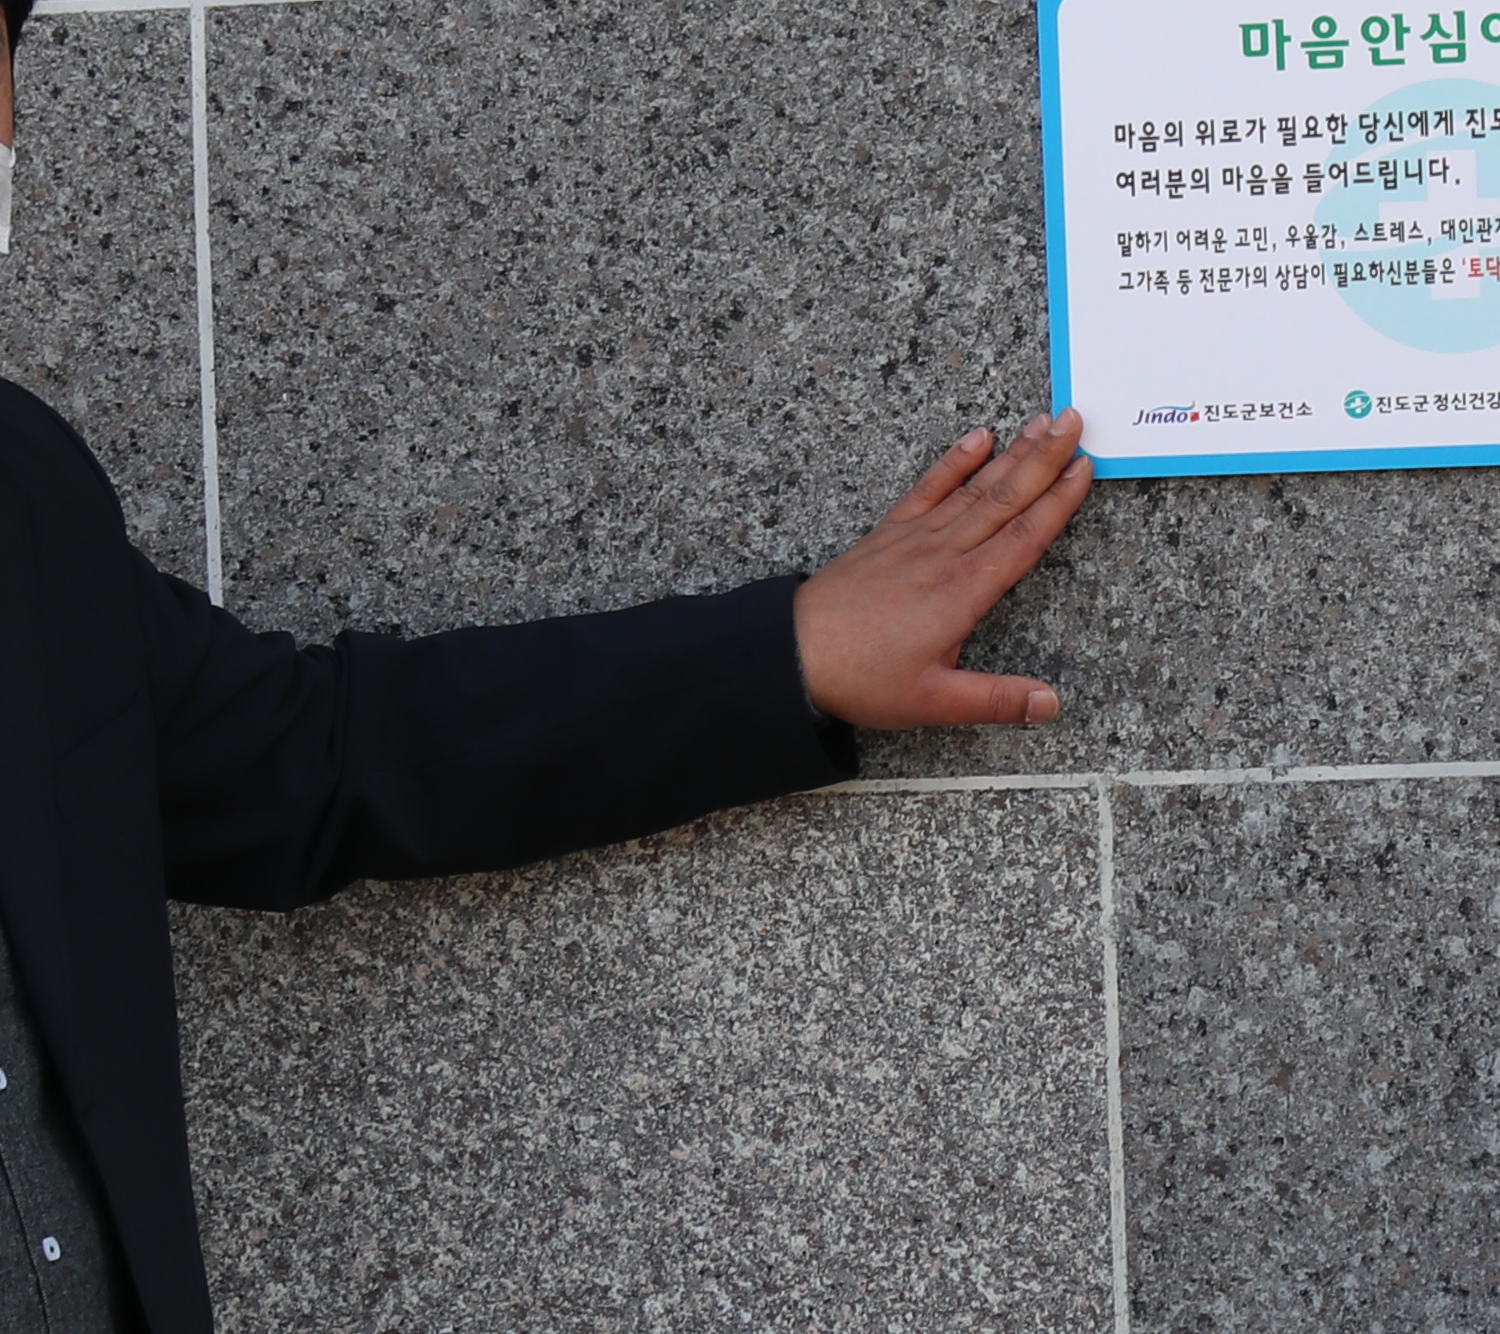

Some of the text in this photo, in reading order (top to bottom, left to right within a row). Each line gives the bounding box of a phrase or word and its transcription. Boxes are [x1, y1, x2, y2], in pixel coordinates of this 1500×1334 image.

[1113, 120, 1185, 153] 마음의
[1194, 117, 1267, 147] 위로가
[1276, 113, 1349, 147] 필요한
[1357, 108, 1455, 144] 당신에게
[1115, 157, 1461, 200] 여러분의 마음을 들어드립니다.
[1116, 230, 1169, 258] 말하기
[1176, 227, 1228, 254] 어려운
[1234, 226, 1277, 253] 고민,
[1285, 223, 1346, 251] 우울감,
[1354, 220, 1433, 246] 스트레스,
[1118, 270, 1170, 296] 그가족
[1176, 268, 1193, 295] 등
[1199, 265, 1269, 294] 전문가의
[1274, 262, 1326, 291] 상담이
[1333, 257, 1456, 287] 필요하신분들은
[1203, 400, 1313, 423] 진도군보건소
